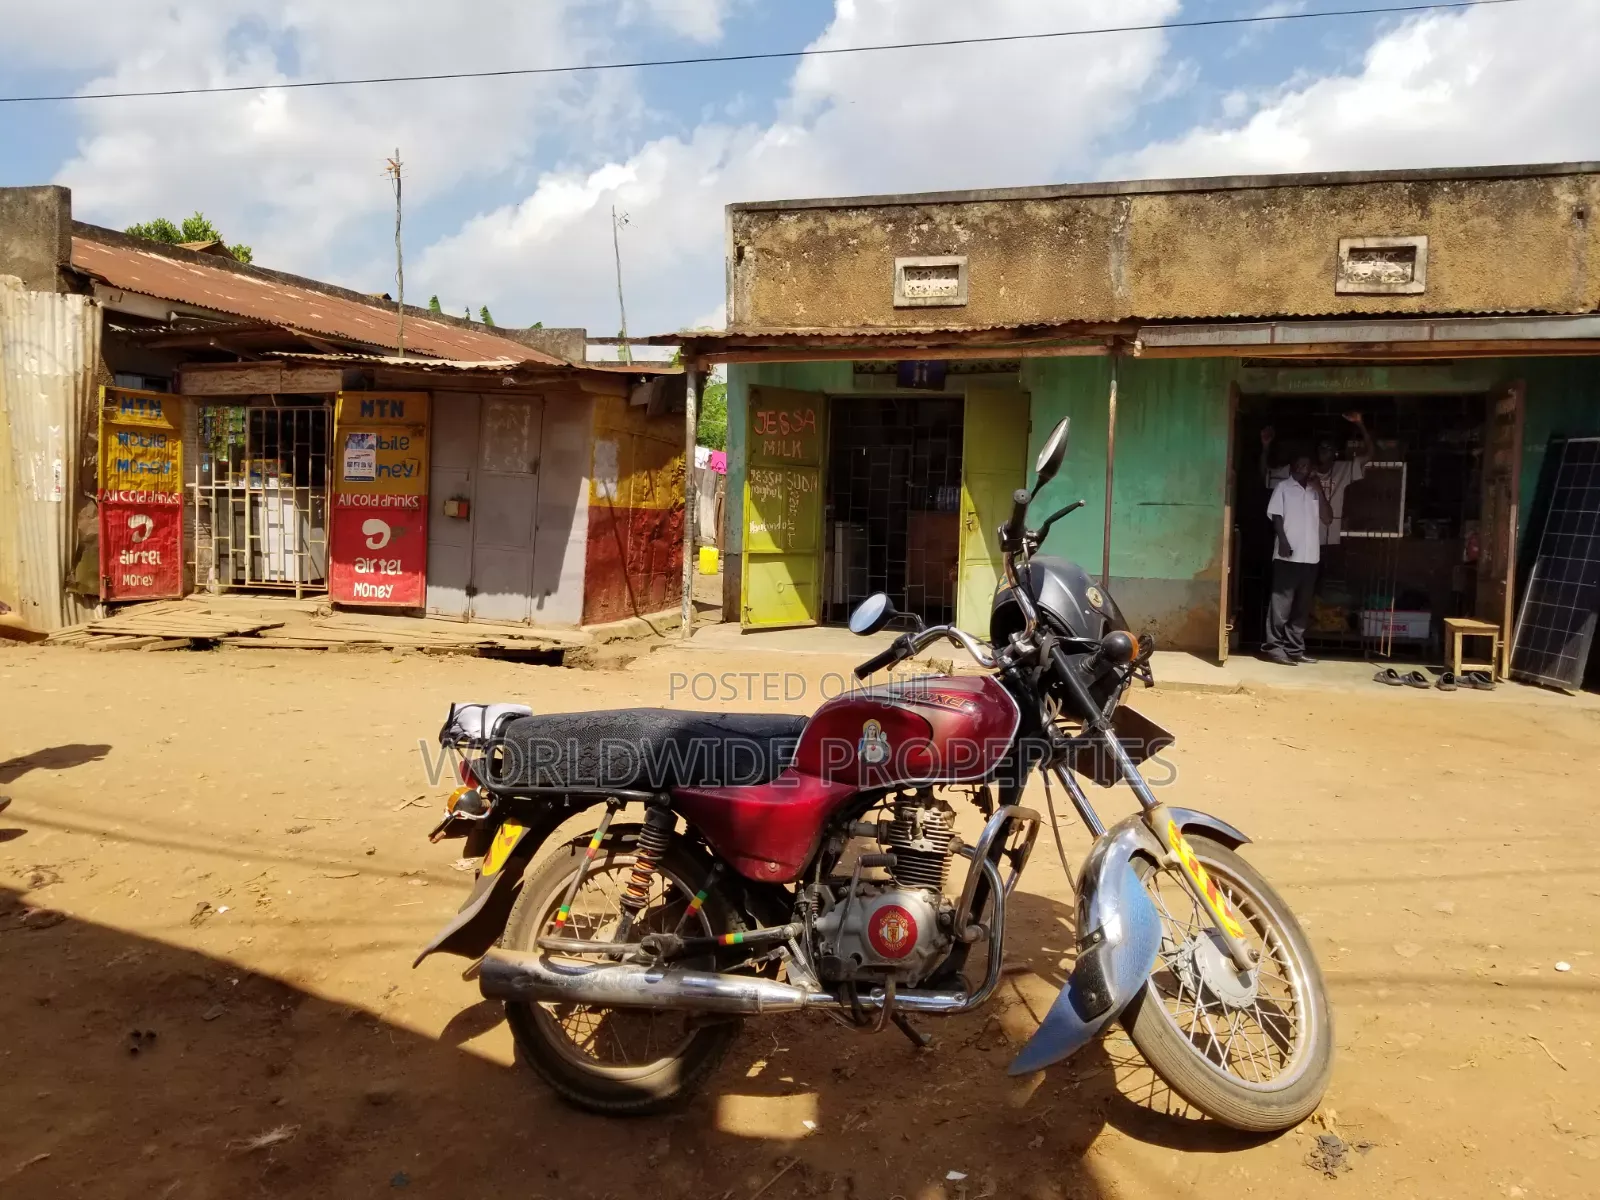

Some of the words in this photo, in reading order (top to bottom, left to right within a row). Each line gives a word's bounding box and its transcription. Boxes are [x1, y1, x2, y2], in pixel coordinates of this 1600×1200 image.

[120, 396, 162, 418] MTN
[361, 400, 405, 418] MTN
[754, 409, 816, 435] JESSA
[763, 440, 803, 458] MILK
[103, 489, 119, 502] All
[338, 493, 351, 507] All
[119, 550, 162, 566] airtel
[354, 557, 403, 575] airtel
